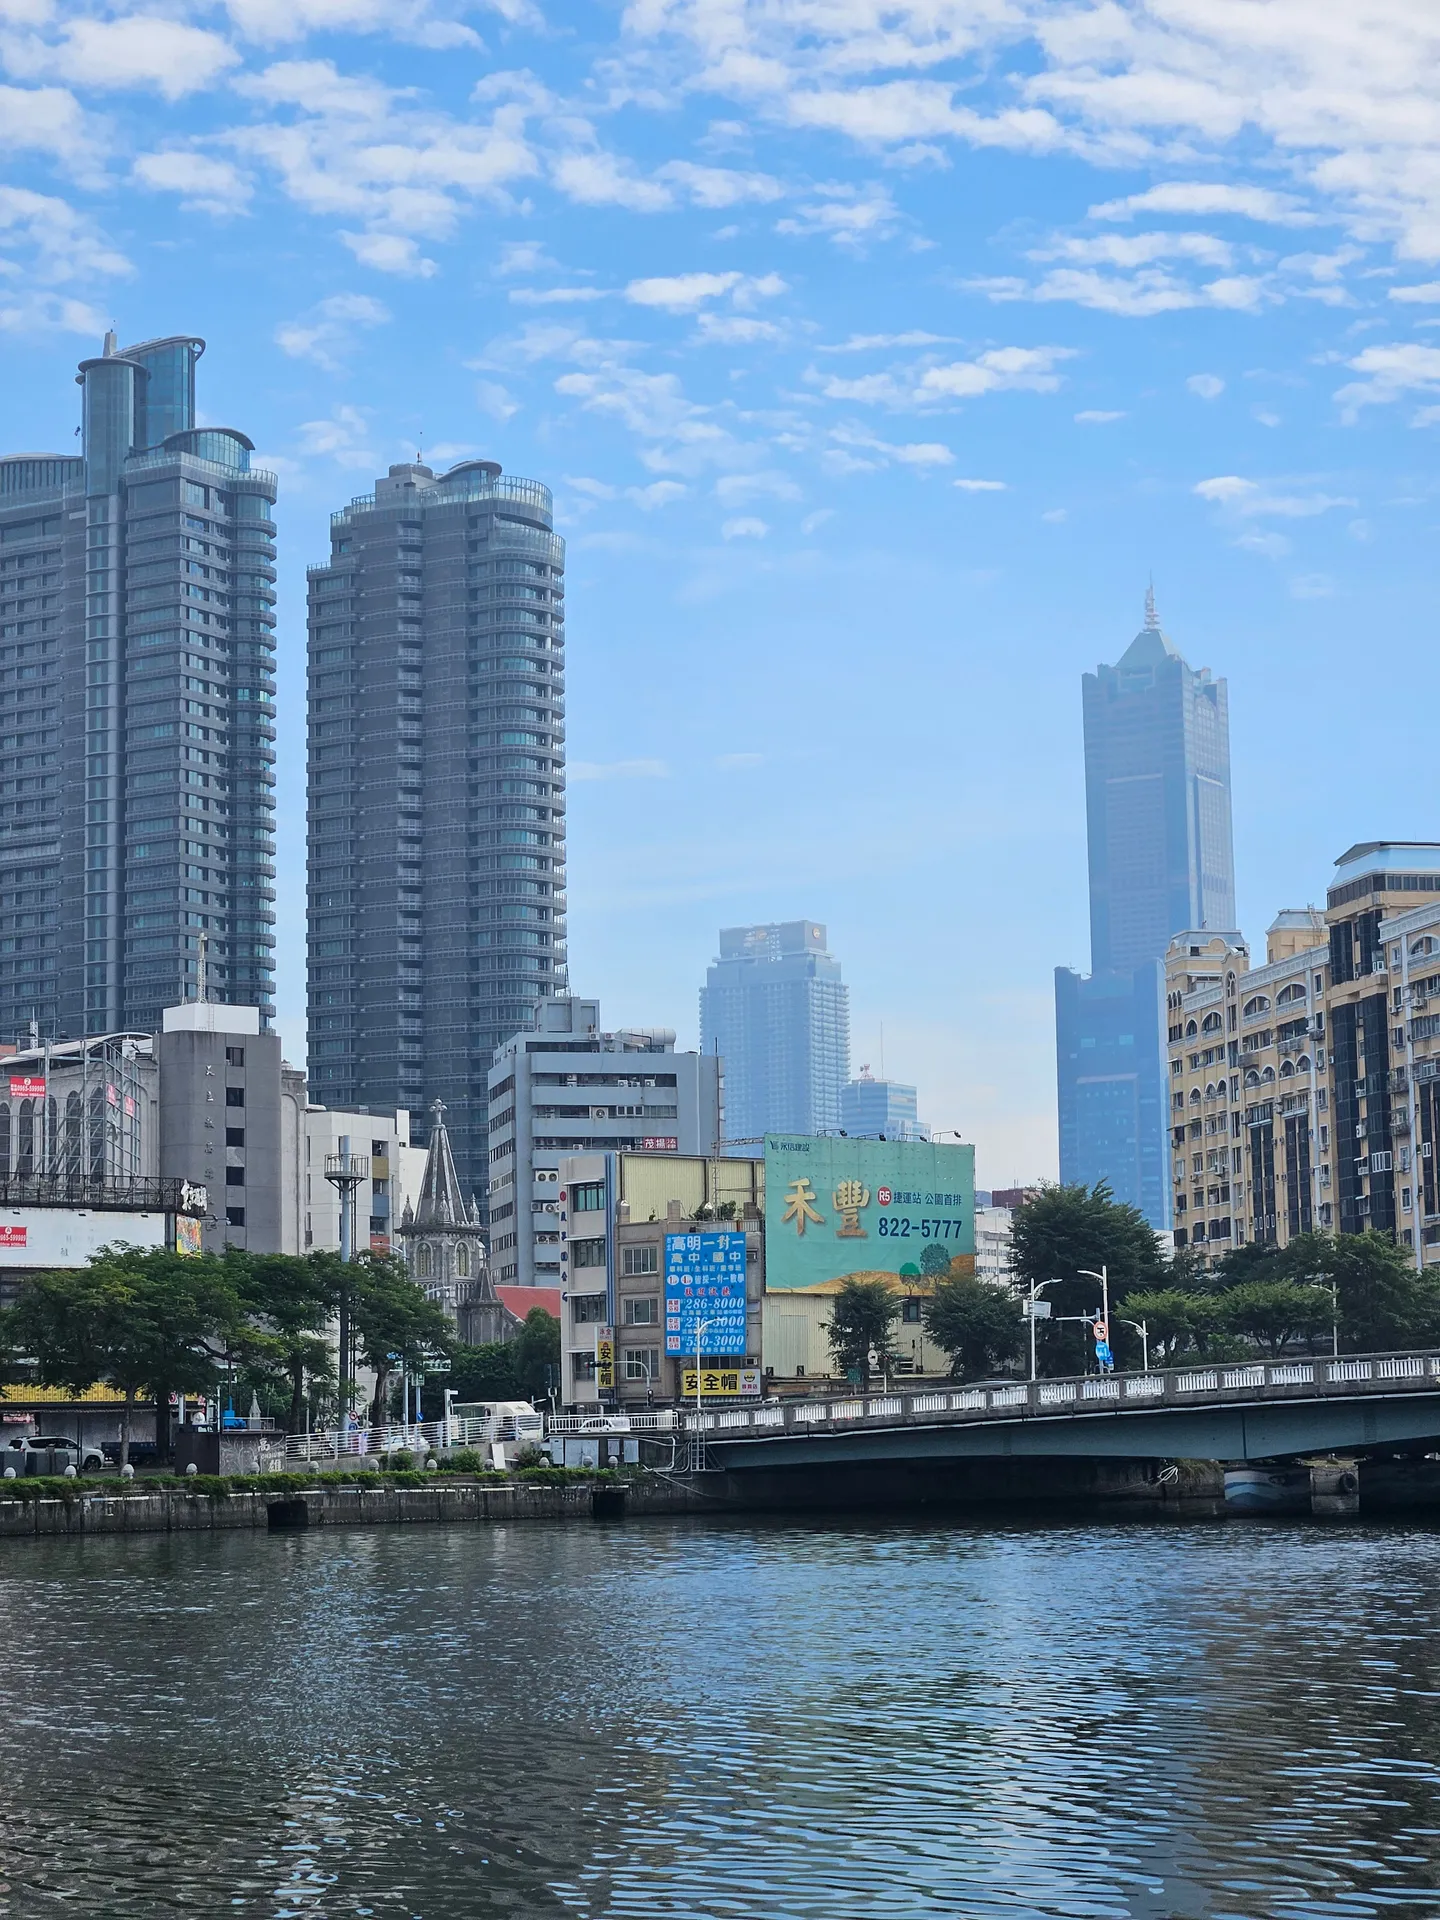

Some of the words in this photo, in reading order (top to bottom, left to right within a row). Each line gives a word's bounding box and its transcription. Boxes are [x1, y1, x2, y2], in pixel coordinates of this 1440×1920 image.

[879, 1190, 891, 1202] R5
[893, 1191, 922, 1204] 捷運站
[924, 1193, 962, 1206] 公園首排
[878, 1217, 962, 1239] 822-5777
[685, 1297, 744, 1309] 286-8000
[686, 1373, 738, 1391] 安全帽
